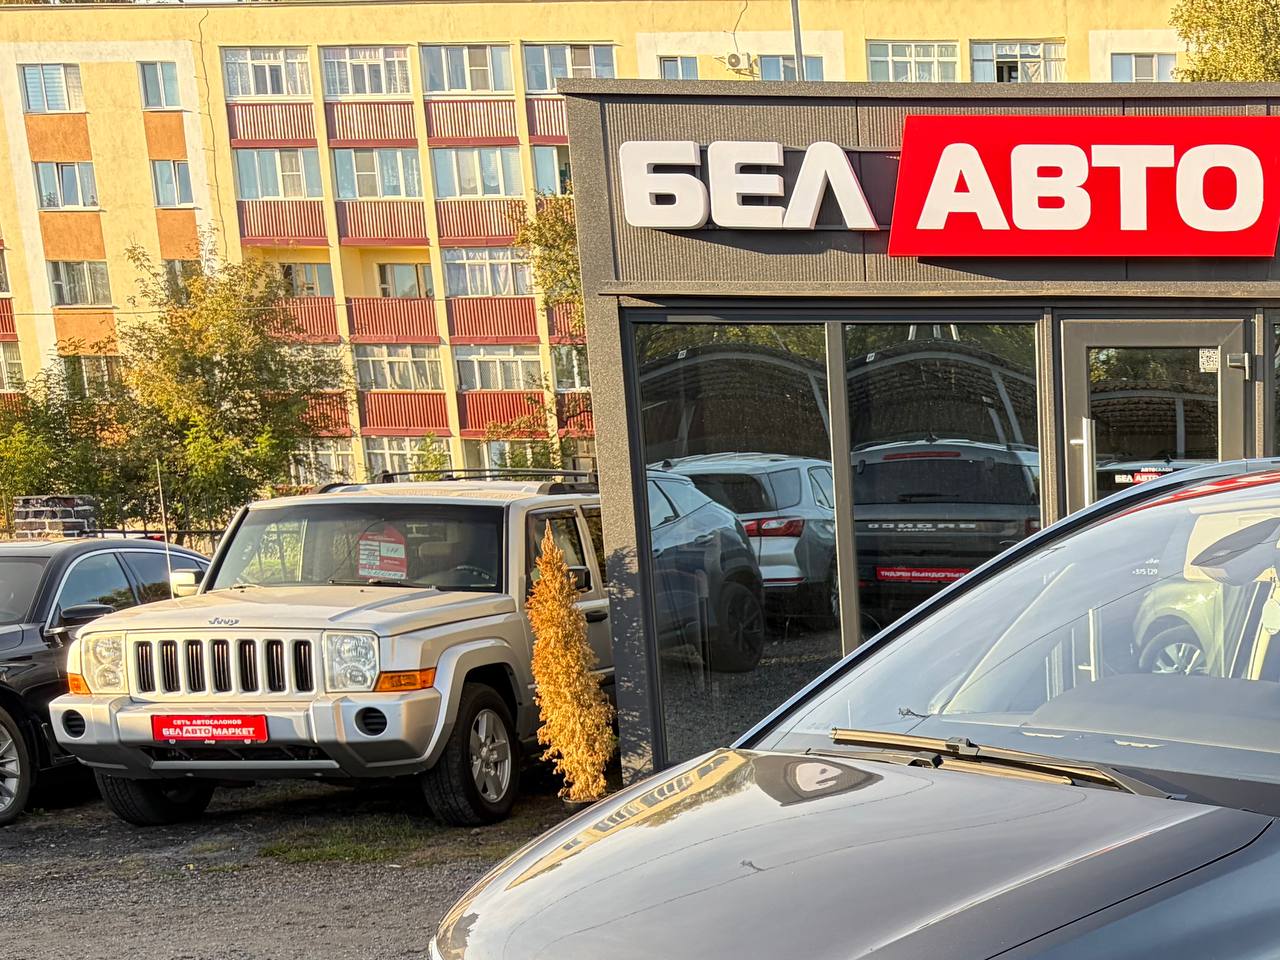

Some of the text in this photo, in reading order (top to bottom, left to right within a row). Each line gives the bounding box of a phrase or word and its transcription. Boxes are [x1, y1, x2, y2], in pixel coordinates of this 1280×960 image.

[619, 140, 879, 230] БЕЛ
[916, 143, 1264, 232] АВТО
[1114, 474, 1133, 484] БЕЛ
[162, 727, 255, 736] БЕЛ АВТО МАРКЕТ
